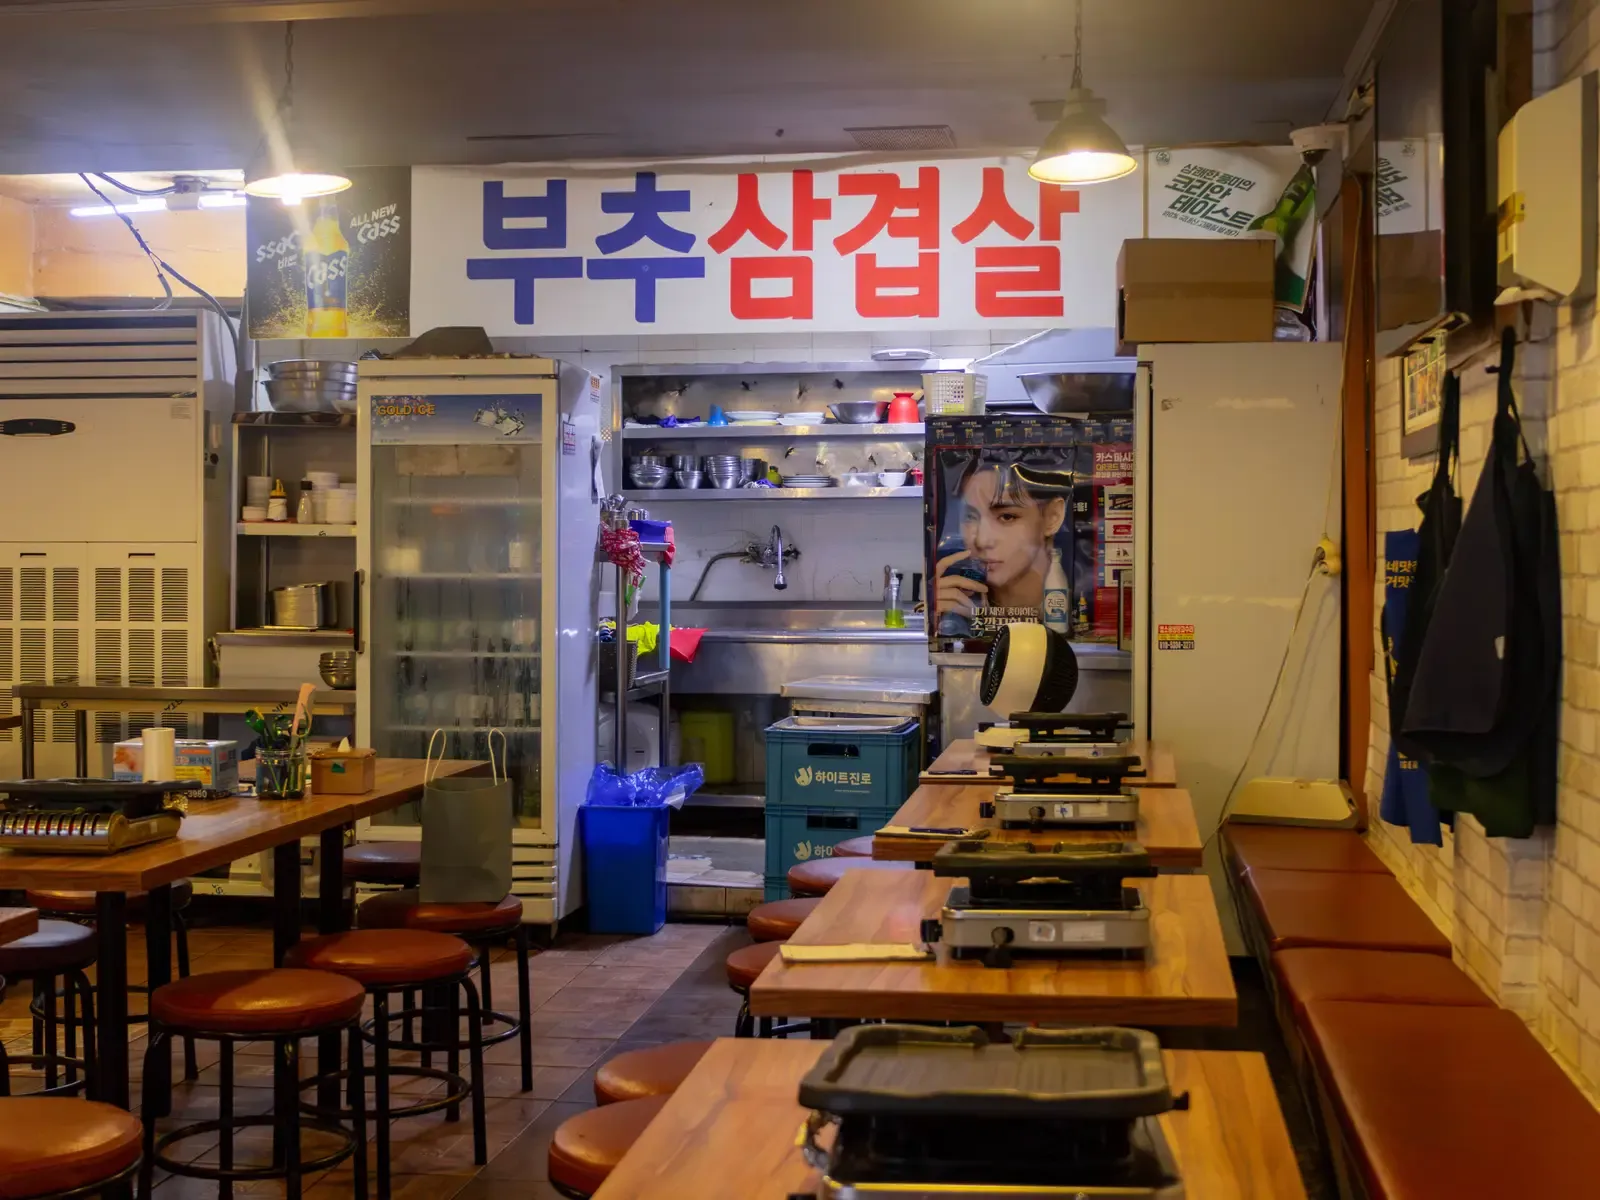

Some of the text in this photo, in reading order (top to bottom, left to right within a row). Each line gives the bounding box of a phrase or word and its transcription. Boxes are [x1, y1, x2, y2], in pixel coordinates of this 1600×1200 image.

[1164, 174, 1233, 203] 코리안
[350, 203, 397, 229] ALL NEW
[1168, 195, 1256, 230] 테이스트
[376, 404, 412, 416] GOLD
[1096, 452, 1113, 463] 카스
[1048, 598, 1065, 608] 진로
[971, 607, 1038, 616] 내가 제일 좋아하는
[815, 771, 872, 785] 하이트진로
